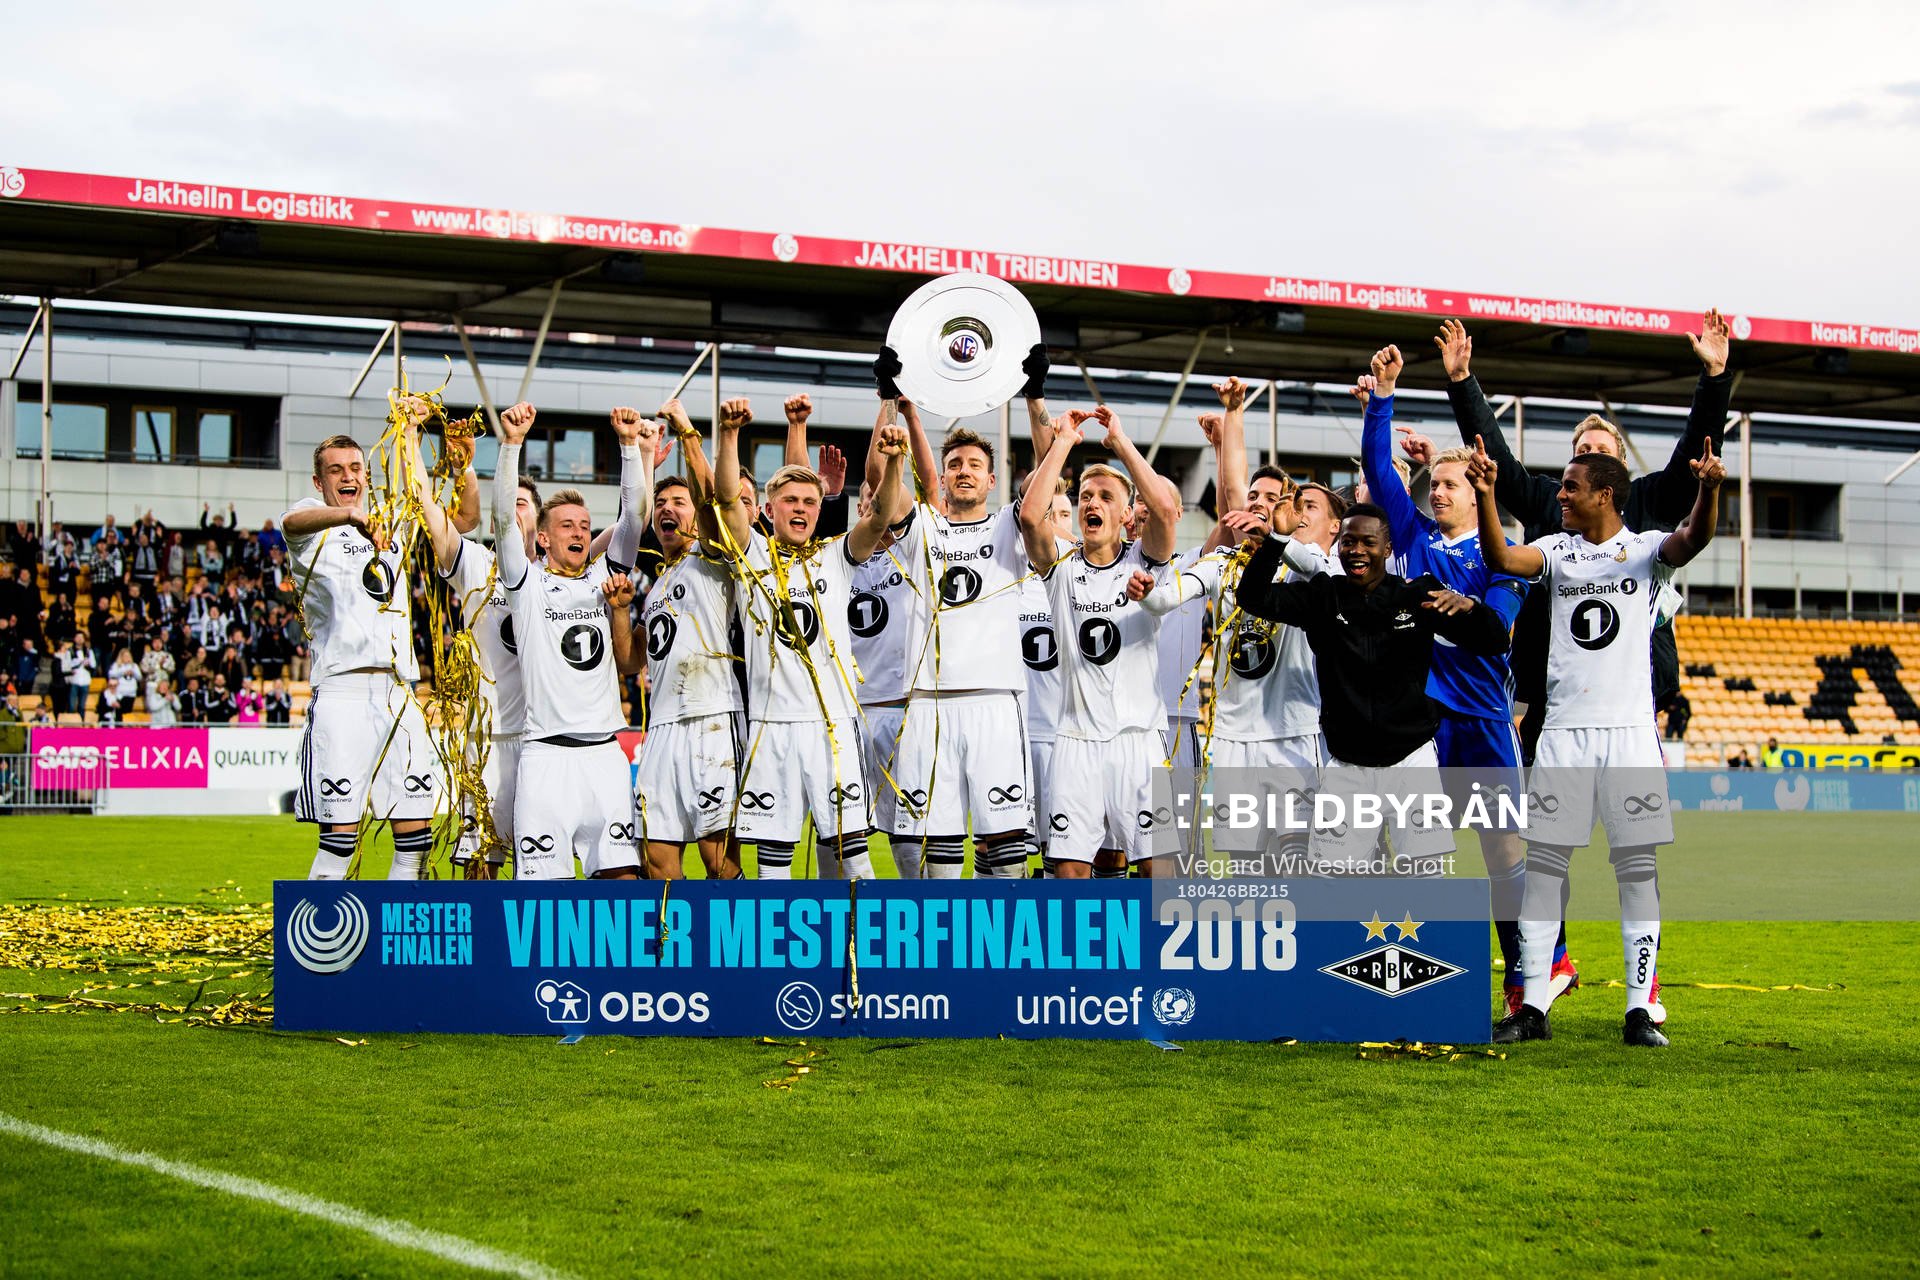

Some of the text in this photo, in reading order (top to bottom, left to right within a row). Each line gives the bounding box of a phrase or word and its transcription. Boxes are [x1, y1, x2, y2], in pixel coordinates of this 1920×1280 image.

[128, 180, 233, 210] Jakhelln
[241, 190, 354, 220] Logistikk
[855, 242, 1118, 287] JAKHELLN TRIBUNEN
[1264, 278, 1341, 303] Jakhelln
[1346, 284, 1428, 309] Logistikk
[1468, 297, 1670, 329] www.logistikkservice.no
[1811, 323, 1857, 344] Norsk
[1558, 582, 1618, 598] SpareBank
[544, 608, 603, 621] SpareBank
[106, 746, 204, 769] ELIXIA
[215, 750, 288, 767] QUALITY
[382, 902, 472, 933] MESTER
[382, 934, 473, 965] FINALEN
[503, 899, 1297, 970] VINNER MESTERFINALEN 2018
[1346, 962, 1440, 979] 19 RBK 17
[1637, 947, 1650, 984] coop
[599, 991, 710, 1023] OBOS
[1017, 986, 1143, 1026] unicef
